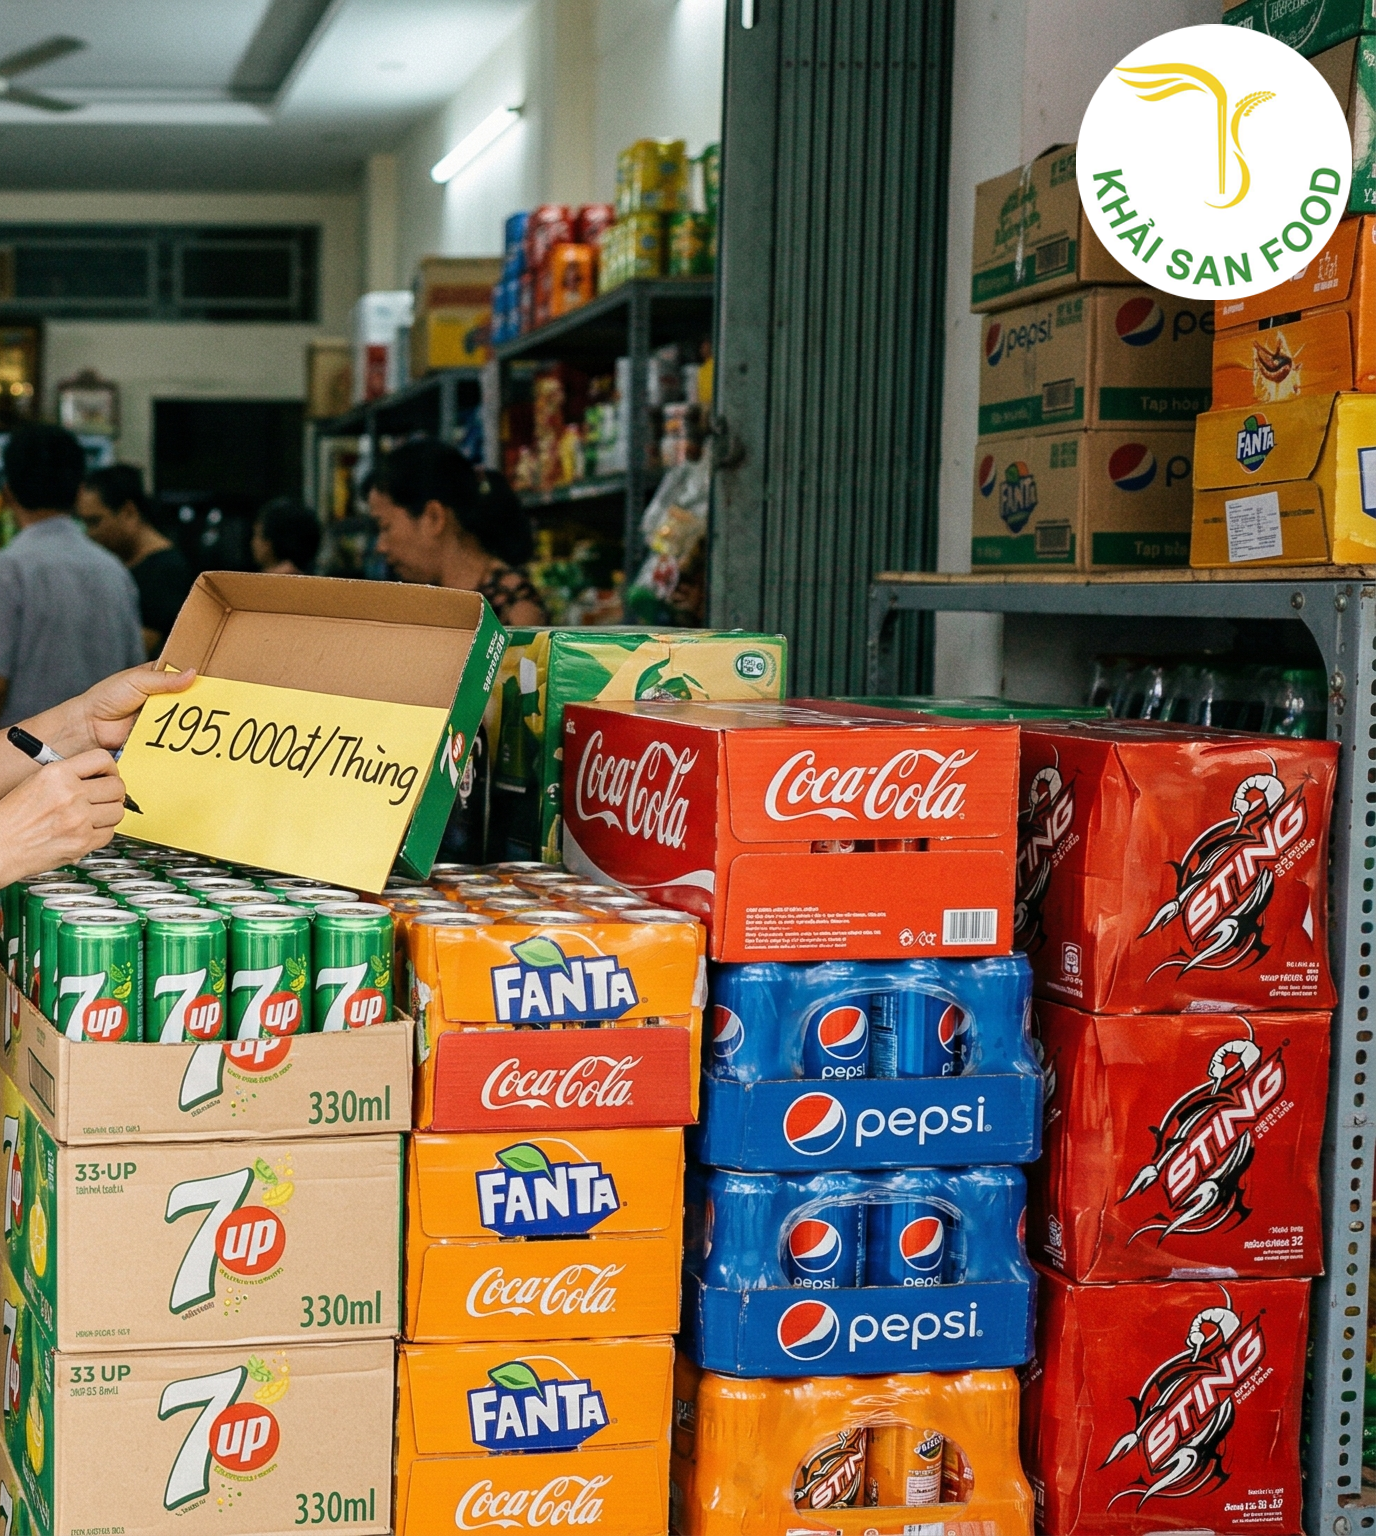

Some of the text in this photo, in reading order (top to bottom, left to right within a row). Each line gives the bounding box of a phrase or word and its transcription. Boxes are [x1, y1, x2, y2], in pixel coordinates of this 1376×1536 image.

[1006, 312, 1053, 359] pepsi
[1237, 425, 1274, 459] FANTA
[145, 702, 419, 806] 195.000đ/Thùng
[575, 730, 700, 851] Coca-Cola
[764, 748, 980, 822] Coca-Cola
[1017, 793, 1073, 888] TING
[1188, 800, 1305, 937] STING
[492, 959, 636, 1021] FANTA
[308, 1085, 391, 1125] 330ml
[481, 1055, 643, 1110] Coca-Cola
[855, 1096, 986, 1147] pepsi
[1168, 1065, 1283, 1199] STING
[478, 1165, 618, 1226] FANTA
[300, 1290, 382, 1328] 330ml
[465, 1263, 627, 1318] Coca-Cola
[849, 1301, 978, 1352] pepsi
[70, 1365, 131, 1383] 33 UP
[1148, 1328, 1264, 1462] STING
[470, 1382, 606, 1442] FANTA
[294, 1488, 376, 1525] 330ml
[454, 1475, 614, 1531] Coca-Cola
